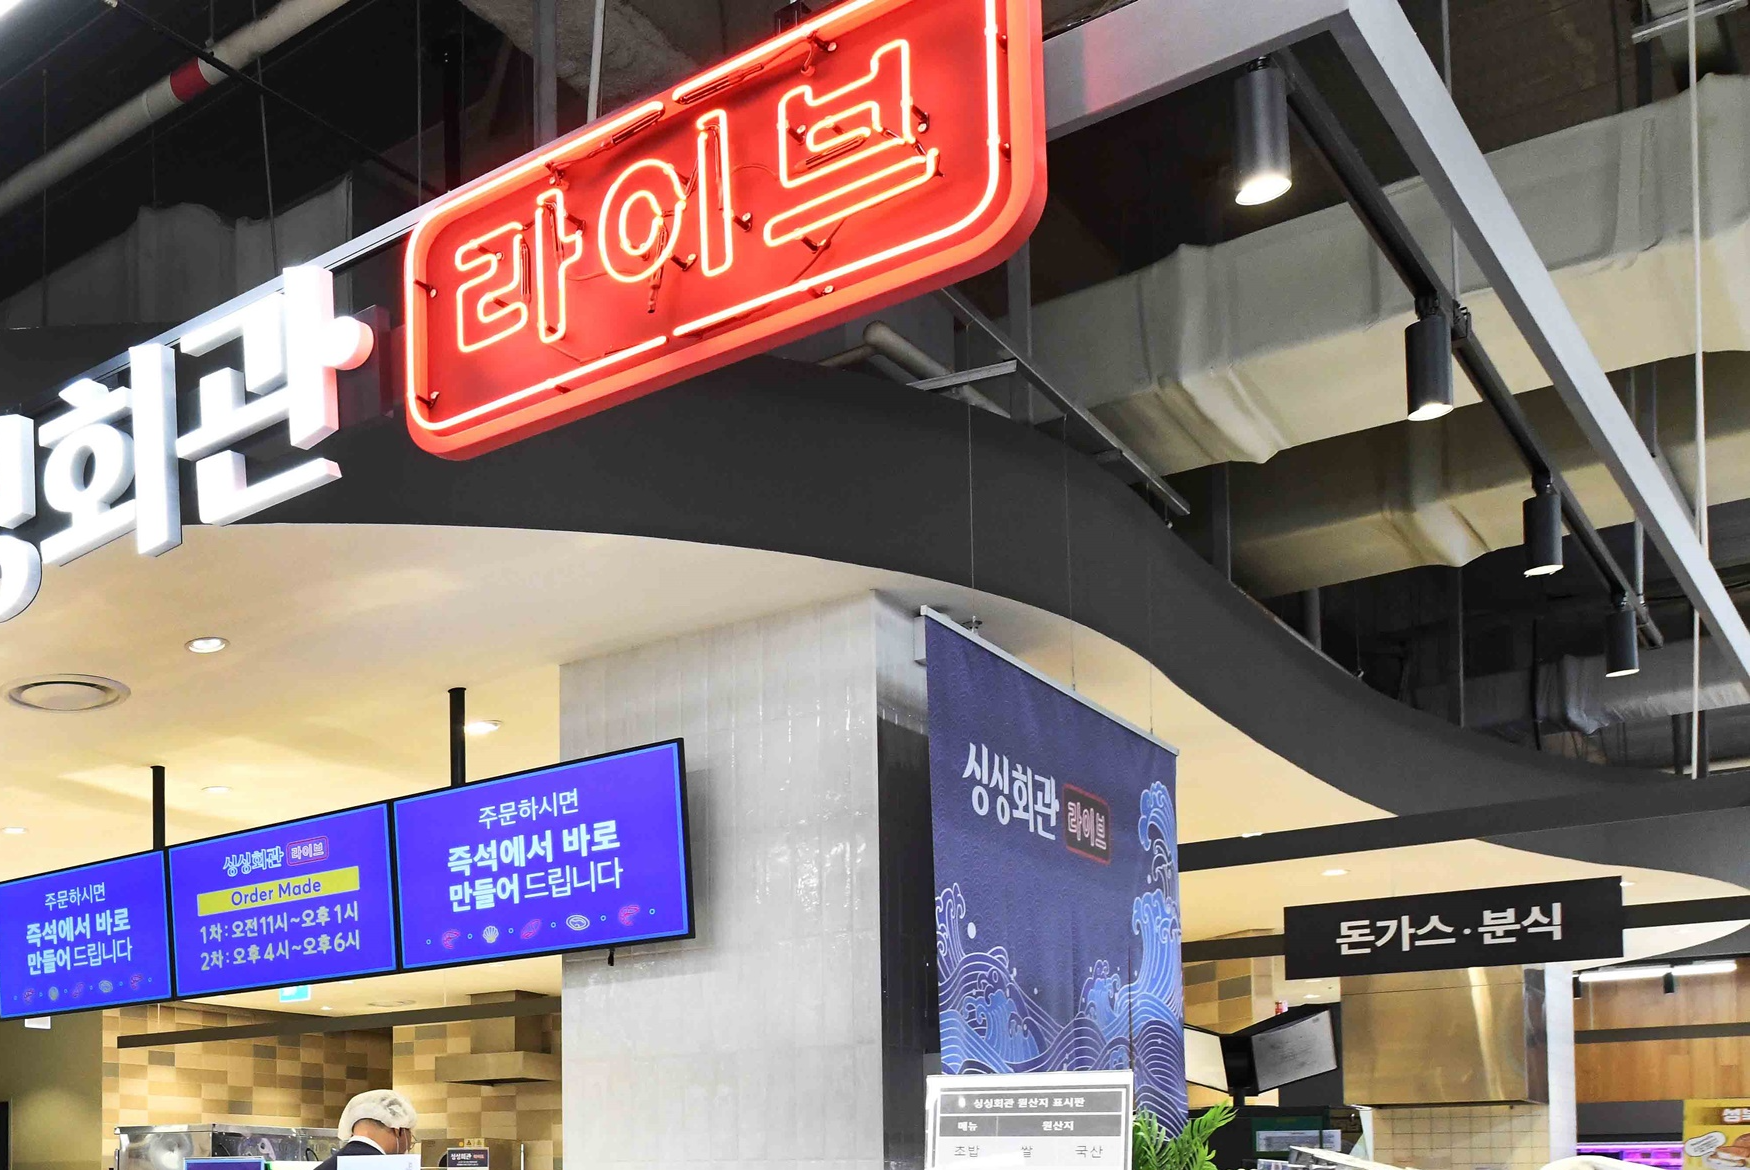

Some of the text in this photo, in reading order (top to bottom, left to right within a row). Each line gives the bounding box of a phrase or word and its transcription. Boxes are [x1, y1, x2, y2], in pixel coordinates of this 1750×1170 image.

[455, 38, 941, 354] 라이브
[478, 787, 579, 830] 주문하시면
[962, 742, 1106, 850] 싱싱회관 라이브
[223, 842, 325, 877] 싱싱회관 라이브
[447, 820, 621, 876] 즉석에서 바로
[44, 882, 106, 911] 주문하시면
[231, 878, 322, 906] Order Made
[449, 856, 624, 913] 만들어 드립니다
[26, 907, 131, 948] 즉석에서 바로
[27, 936, 133, 976] 만들어 드립니다
[973, 1096, 1086, 1109] 싱싱회관 원산지 표시판
[957, 1120, 1075, 1132] 메뉴 원산지
[1020, 1144, 1034, 1158] 쌀
[1074, 1144, 1104, 1159] 국산
